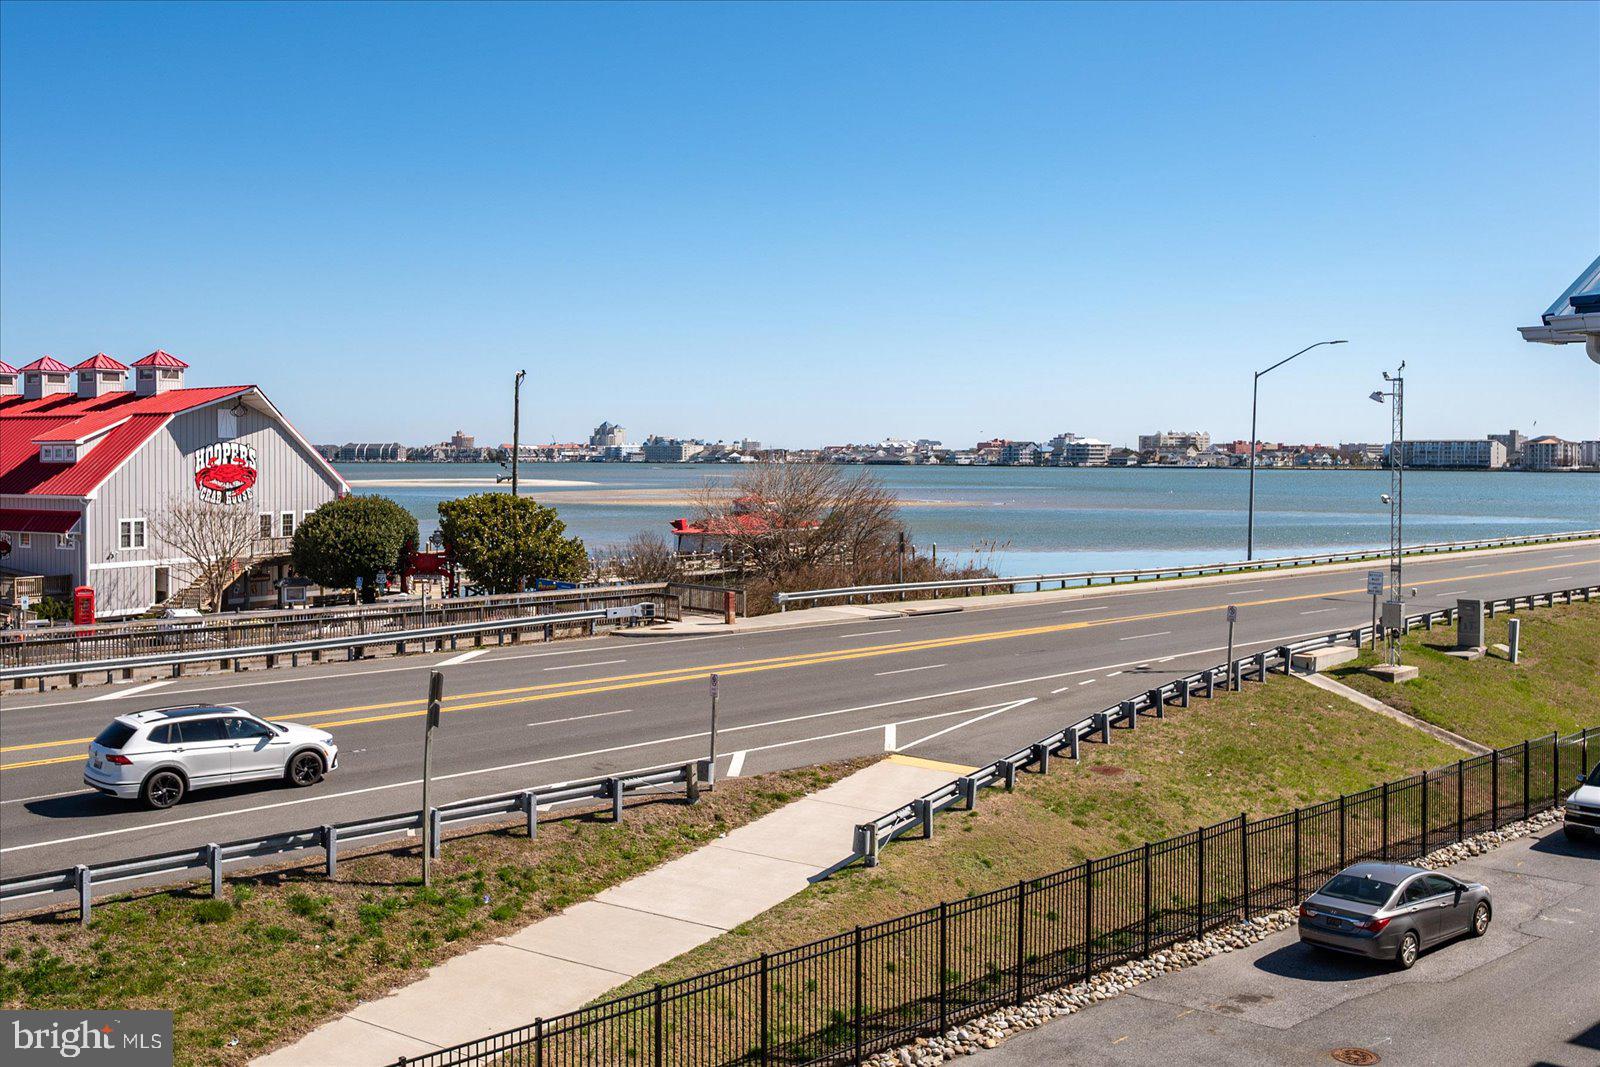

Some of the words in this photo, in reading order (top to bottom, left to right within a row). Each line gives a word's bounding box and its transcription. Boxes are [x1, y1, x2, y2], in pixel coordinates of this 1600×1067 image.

[195, 442, 257, 473] HOOPER'S
[199, 486, 222, 504] CRAB
[225, 487, 254, 504] HOUSE
